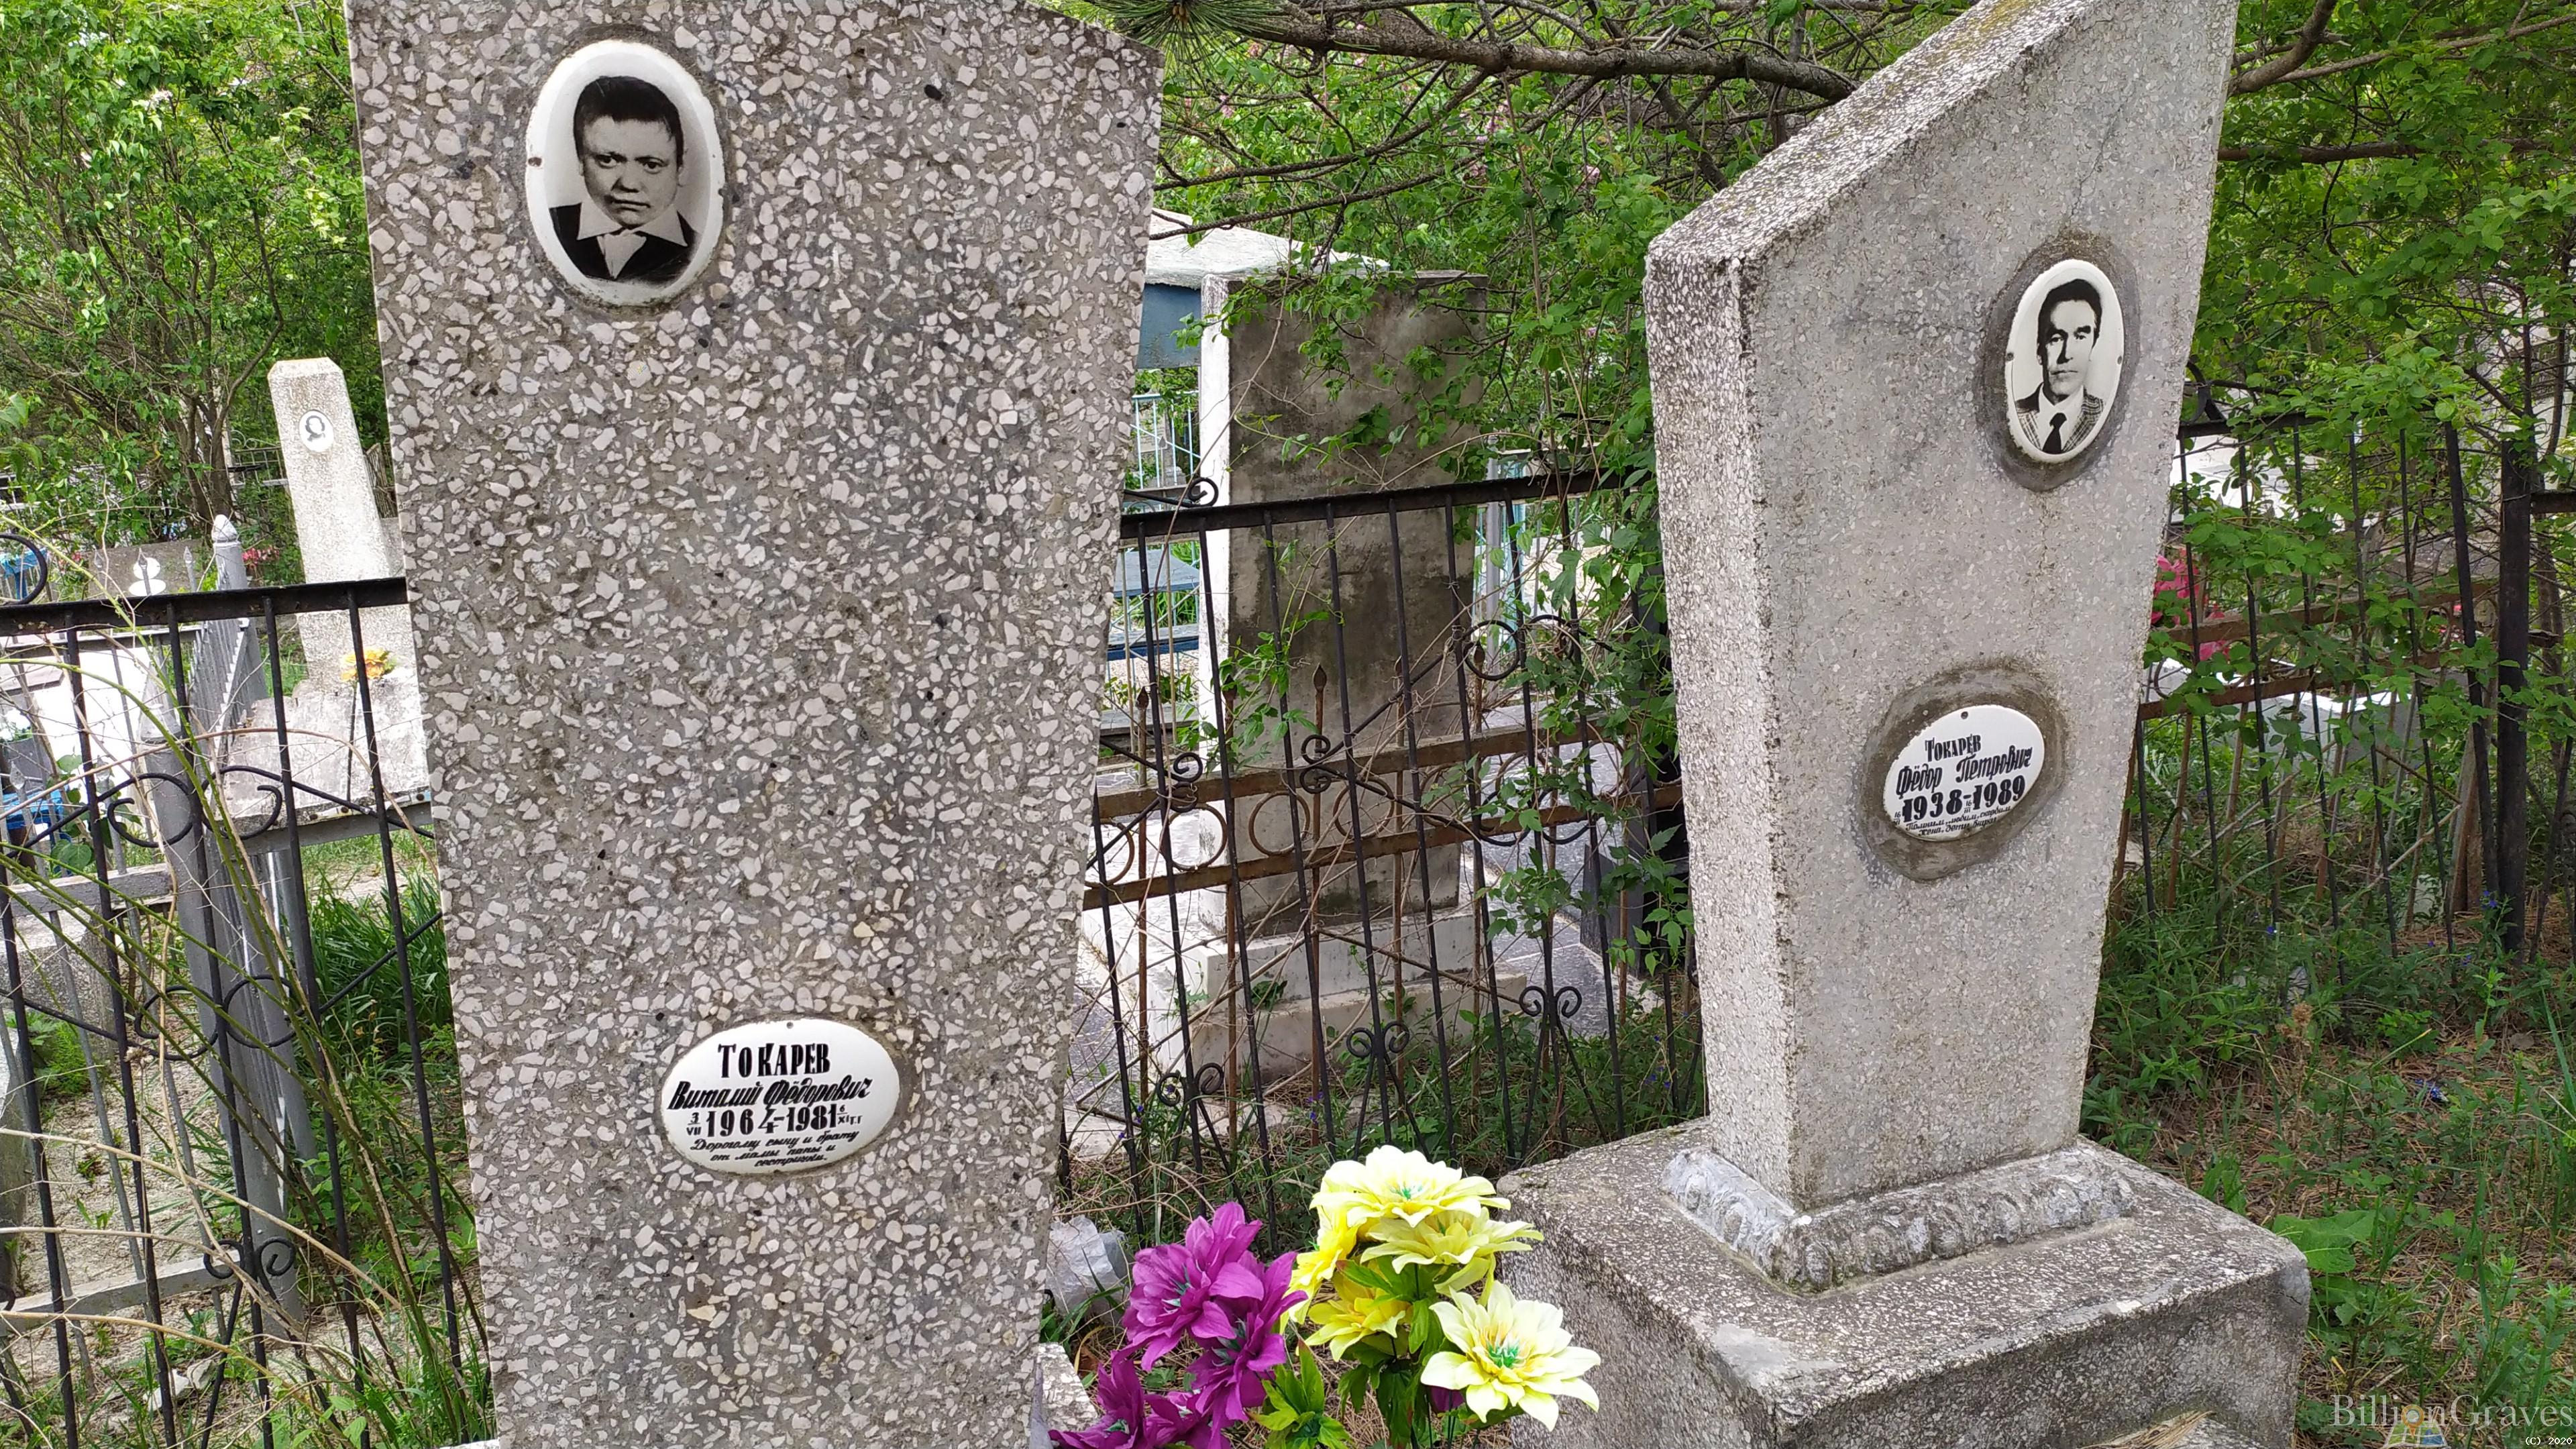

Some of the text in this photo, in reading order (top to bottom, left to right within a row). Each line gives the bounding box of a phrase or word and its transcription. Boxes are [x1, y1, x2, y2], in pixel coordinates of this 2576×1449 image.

[1925, 734, 1981, 762] ТОКАРЕВ
[1896, 745, 2033, 799] Фёдор Петрович
[718, 1043, 830, 1078] ТОКАРЕВ
[667, 1075, 873, 1110] Виталий Фёдорович
[816, 1130, 859, 1144] брату
